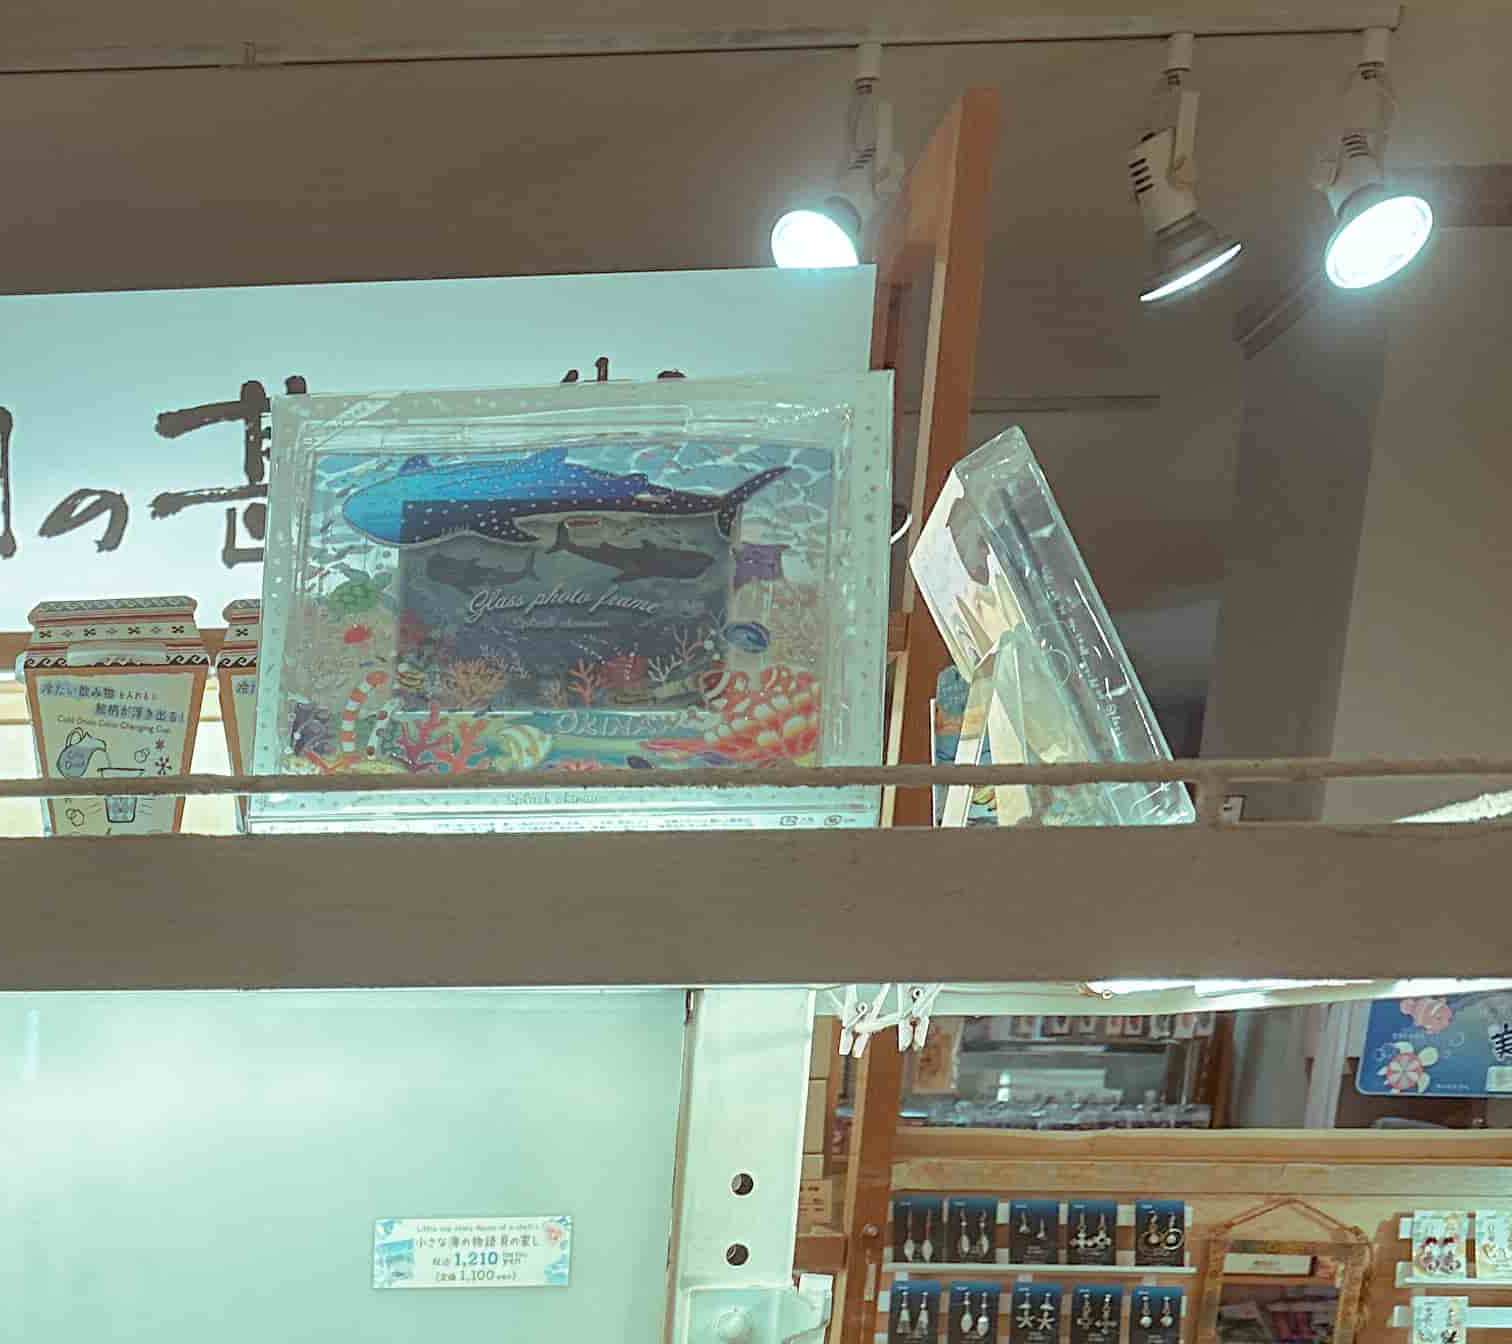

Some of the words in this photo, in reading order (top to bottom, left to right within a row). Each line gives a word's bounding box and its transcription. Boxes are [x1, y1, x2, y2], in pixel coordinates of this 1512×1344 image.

[464, 587, 523, 624] Glass
[527, 584, 589, 614] photo
[454, 1251, 498, 1267] 1,210
[460, 1269, 494, 1282] 1,100
